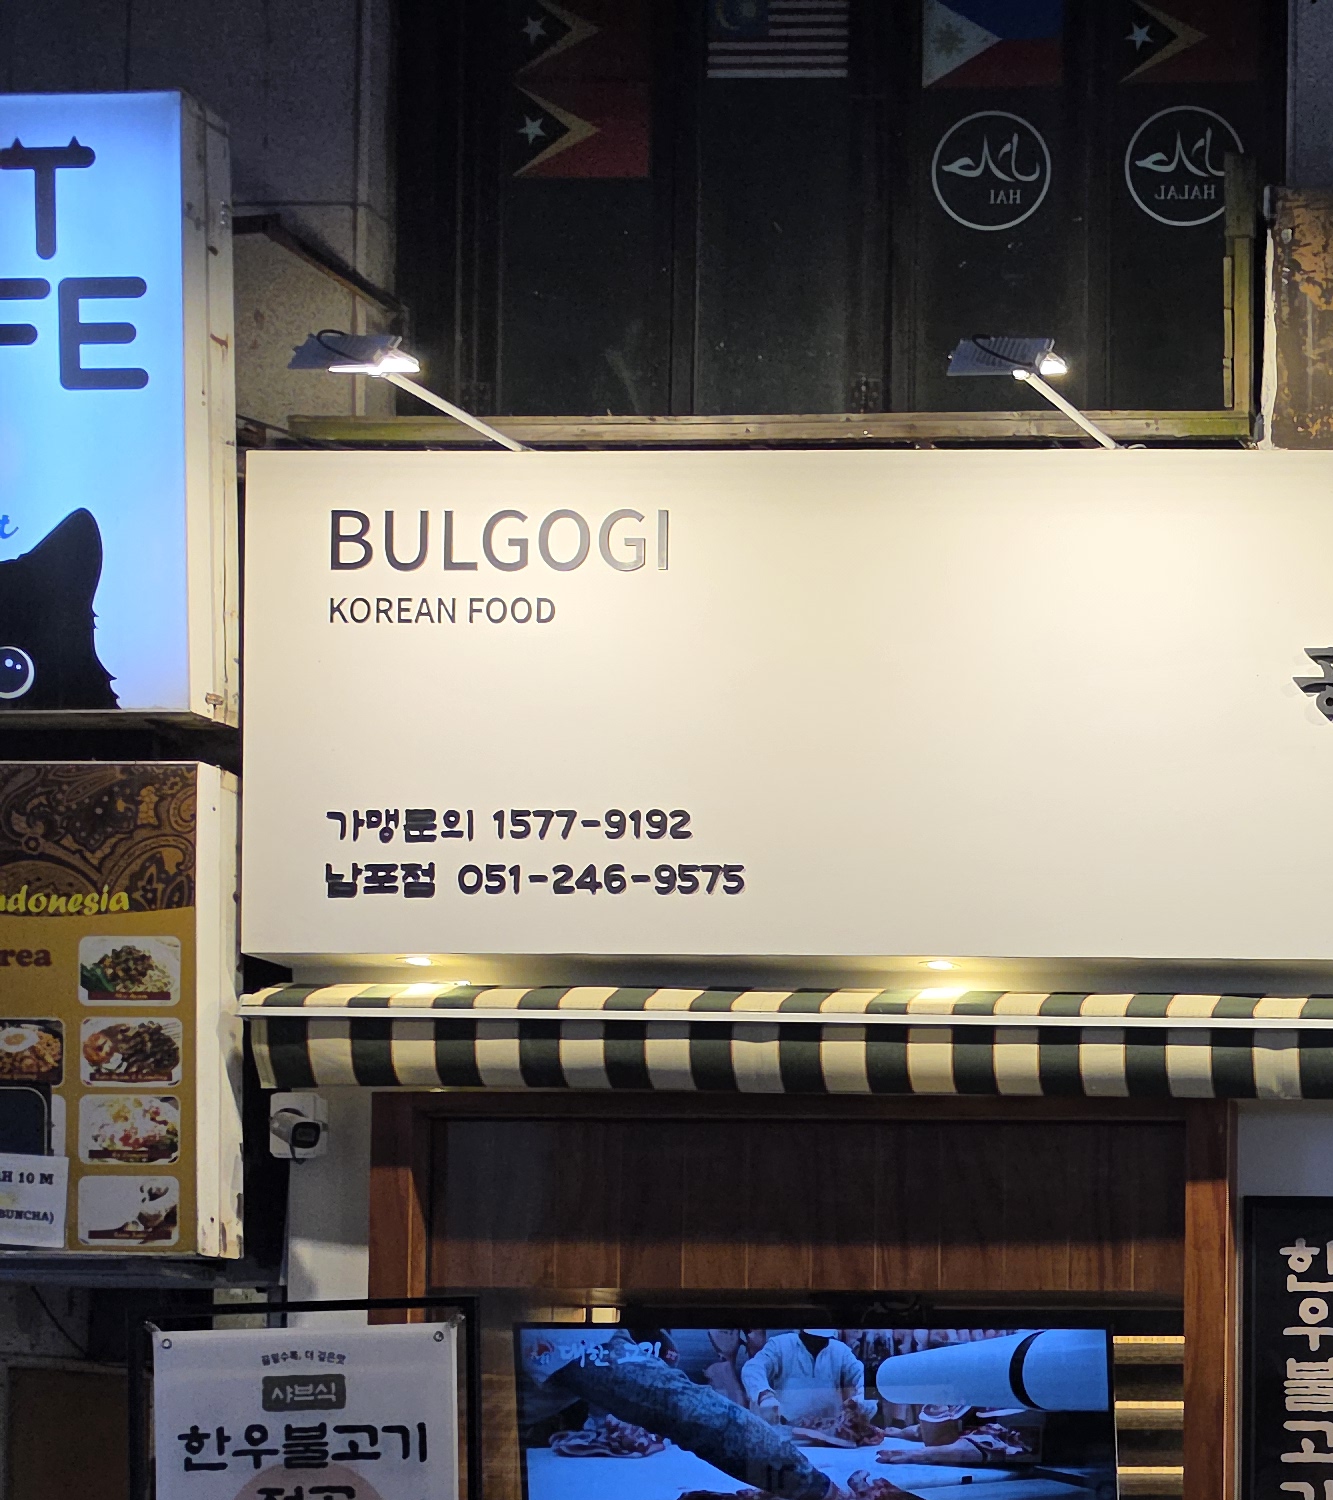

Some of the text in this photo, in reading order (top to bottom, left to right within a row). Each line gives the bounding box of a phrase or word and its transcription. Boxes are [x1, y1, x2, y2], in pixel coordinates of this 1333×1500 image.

[330, 508, 669, 572] BULGOGI
[329, 597, 556, 624] KOREAN FOOD
[326, 808, 693, 843] 가맹문의 1577-9192
[325, 862, 747, 898] 남포점 051-246-9575
[18, 1172, 35, 1184] 10
[40, 1173, 54, 1185] M
[271, 1382, 337, 1404] 샤브식
[177, 1421, 428, 1473] 한우불고기
